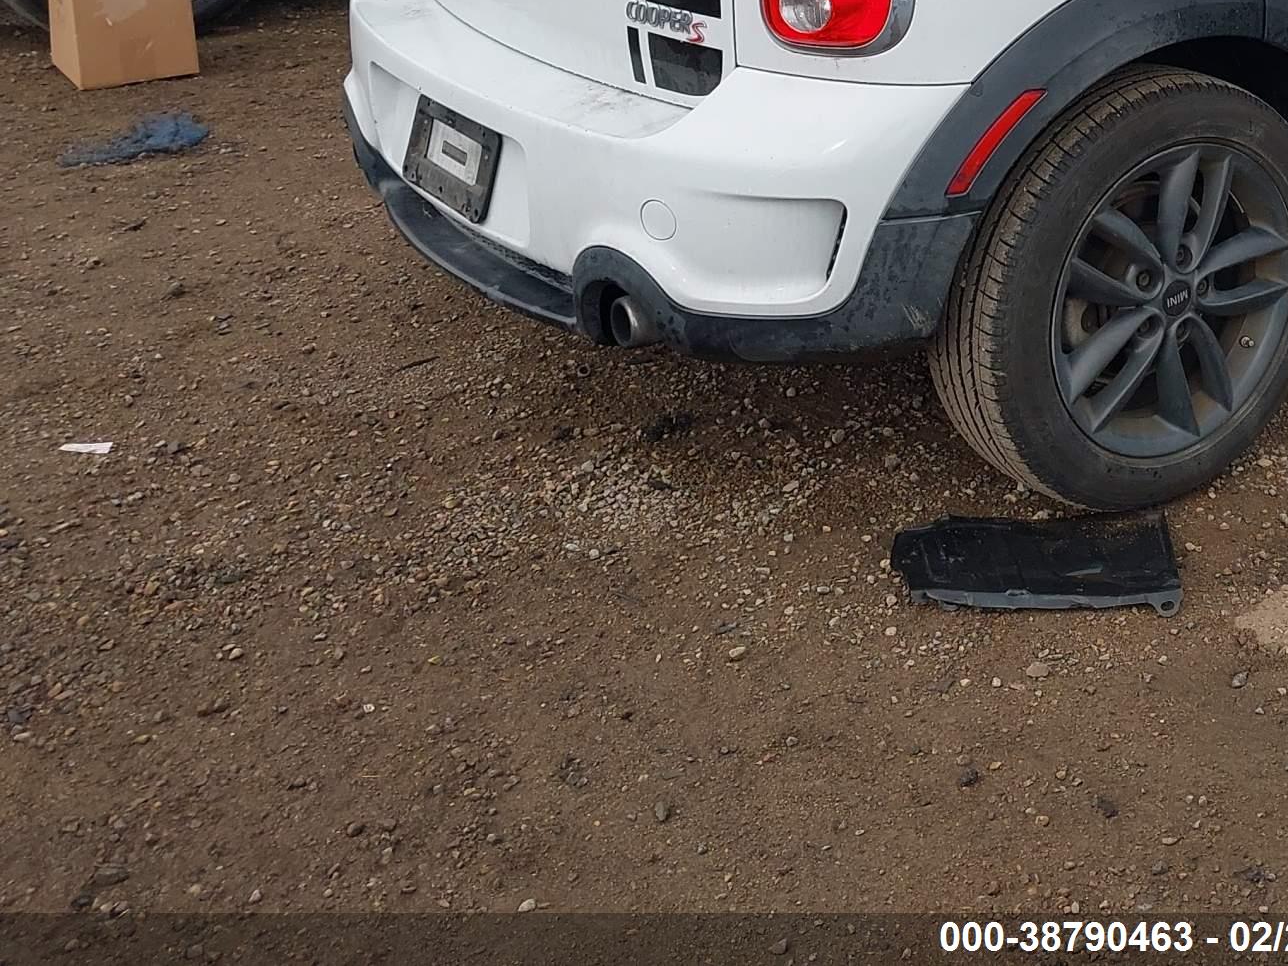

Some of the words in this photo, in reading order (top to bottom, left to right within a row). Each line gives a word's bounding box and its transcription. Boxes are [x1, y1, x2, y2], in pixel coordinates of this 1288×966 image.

[626, 0, 693, 34] COOPER
[686, 21, 707, 43] S
[1166, 289, 1189, 309] MINI
